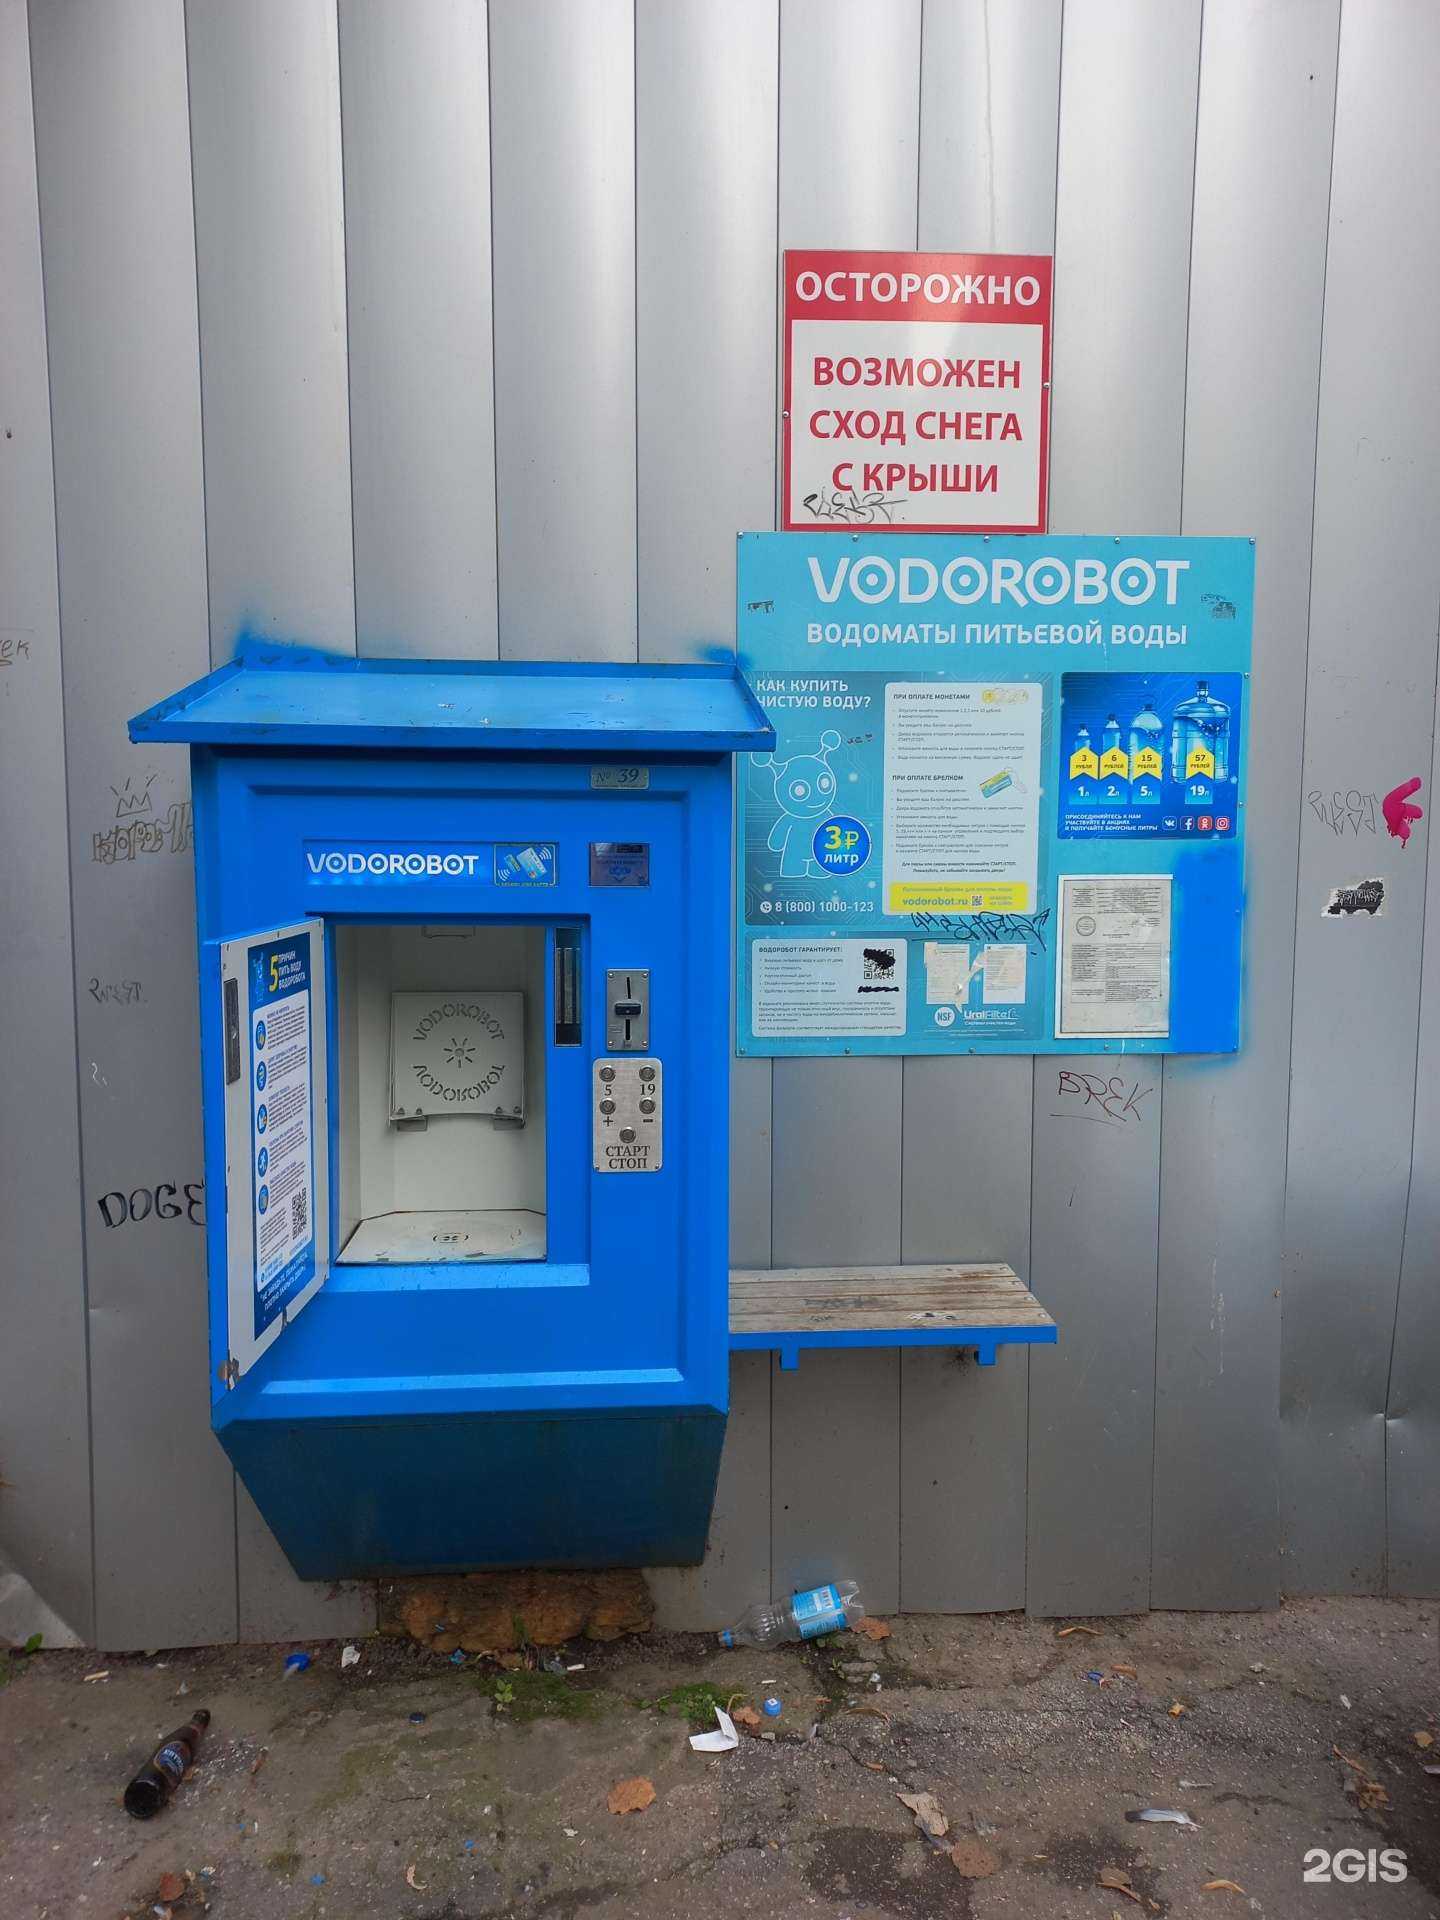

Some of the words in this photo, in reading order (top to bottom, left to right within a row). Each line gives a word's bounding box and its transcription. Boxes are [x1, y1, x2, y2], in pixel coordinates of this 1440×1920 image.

[795, 271, 1041, 306] ОСТОРОЖНО
[813, 357, 1021, 389] ВОЗМОЖЕН
[809, 410, 906, 446] СХОД
[915, 411, 1023, 441] СНЕГА
[832, 463, 854, 492] С
[863, 464, 998, 492] КРЫШИ
[807, 556, 1190, 608] VODOROBOT
[807, 623, 957, 647] ВОДОМАТЫ
[965, 620, 1103, 647] ПИТЬЕВОЙ
[1111, 624, 1188, 649] ВОДЫ
[756, 679, 786, 692] КАК
[790, 679, 849, 692] КУПИТЬ
[758, 695, 818, 707] ЧИСТУЮ
[823, 696, 871, 708] ВОДУ?
[1080, 754, 1087, 762] 3
[1111, 754, 1118, 762] 6
[1141, 754, 1153, 762] 15
[1195, 754, 1206, 762] 57
[617, 768, 640, 783] 39
[306, 852, 480, 875] VODOROBOT
[824, 854, 859, 868] литр
[902, 895, 968, 906] vodorobot.ru
[775, 902, 783, 912] 8
[785, 902, 816, 913] (800)
[819, 902, 874, 912] 1000-123
[269, 954, 279, 992] 5
[413, 1003, 505, 1040] VODOROBOT
[937, 1011, 952, 1021] NSF
[605, 1084, 612, 1096] 5
[640, 1084, 656, 1096] 19
[606, 1145, 651, 1158] СТАРТ
[609, 1158, 647, 1169] СТОП
